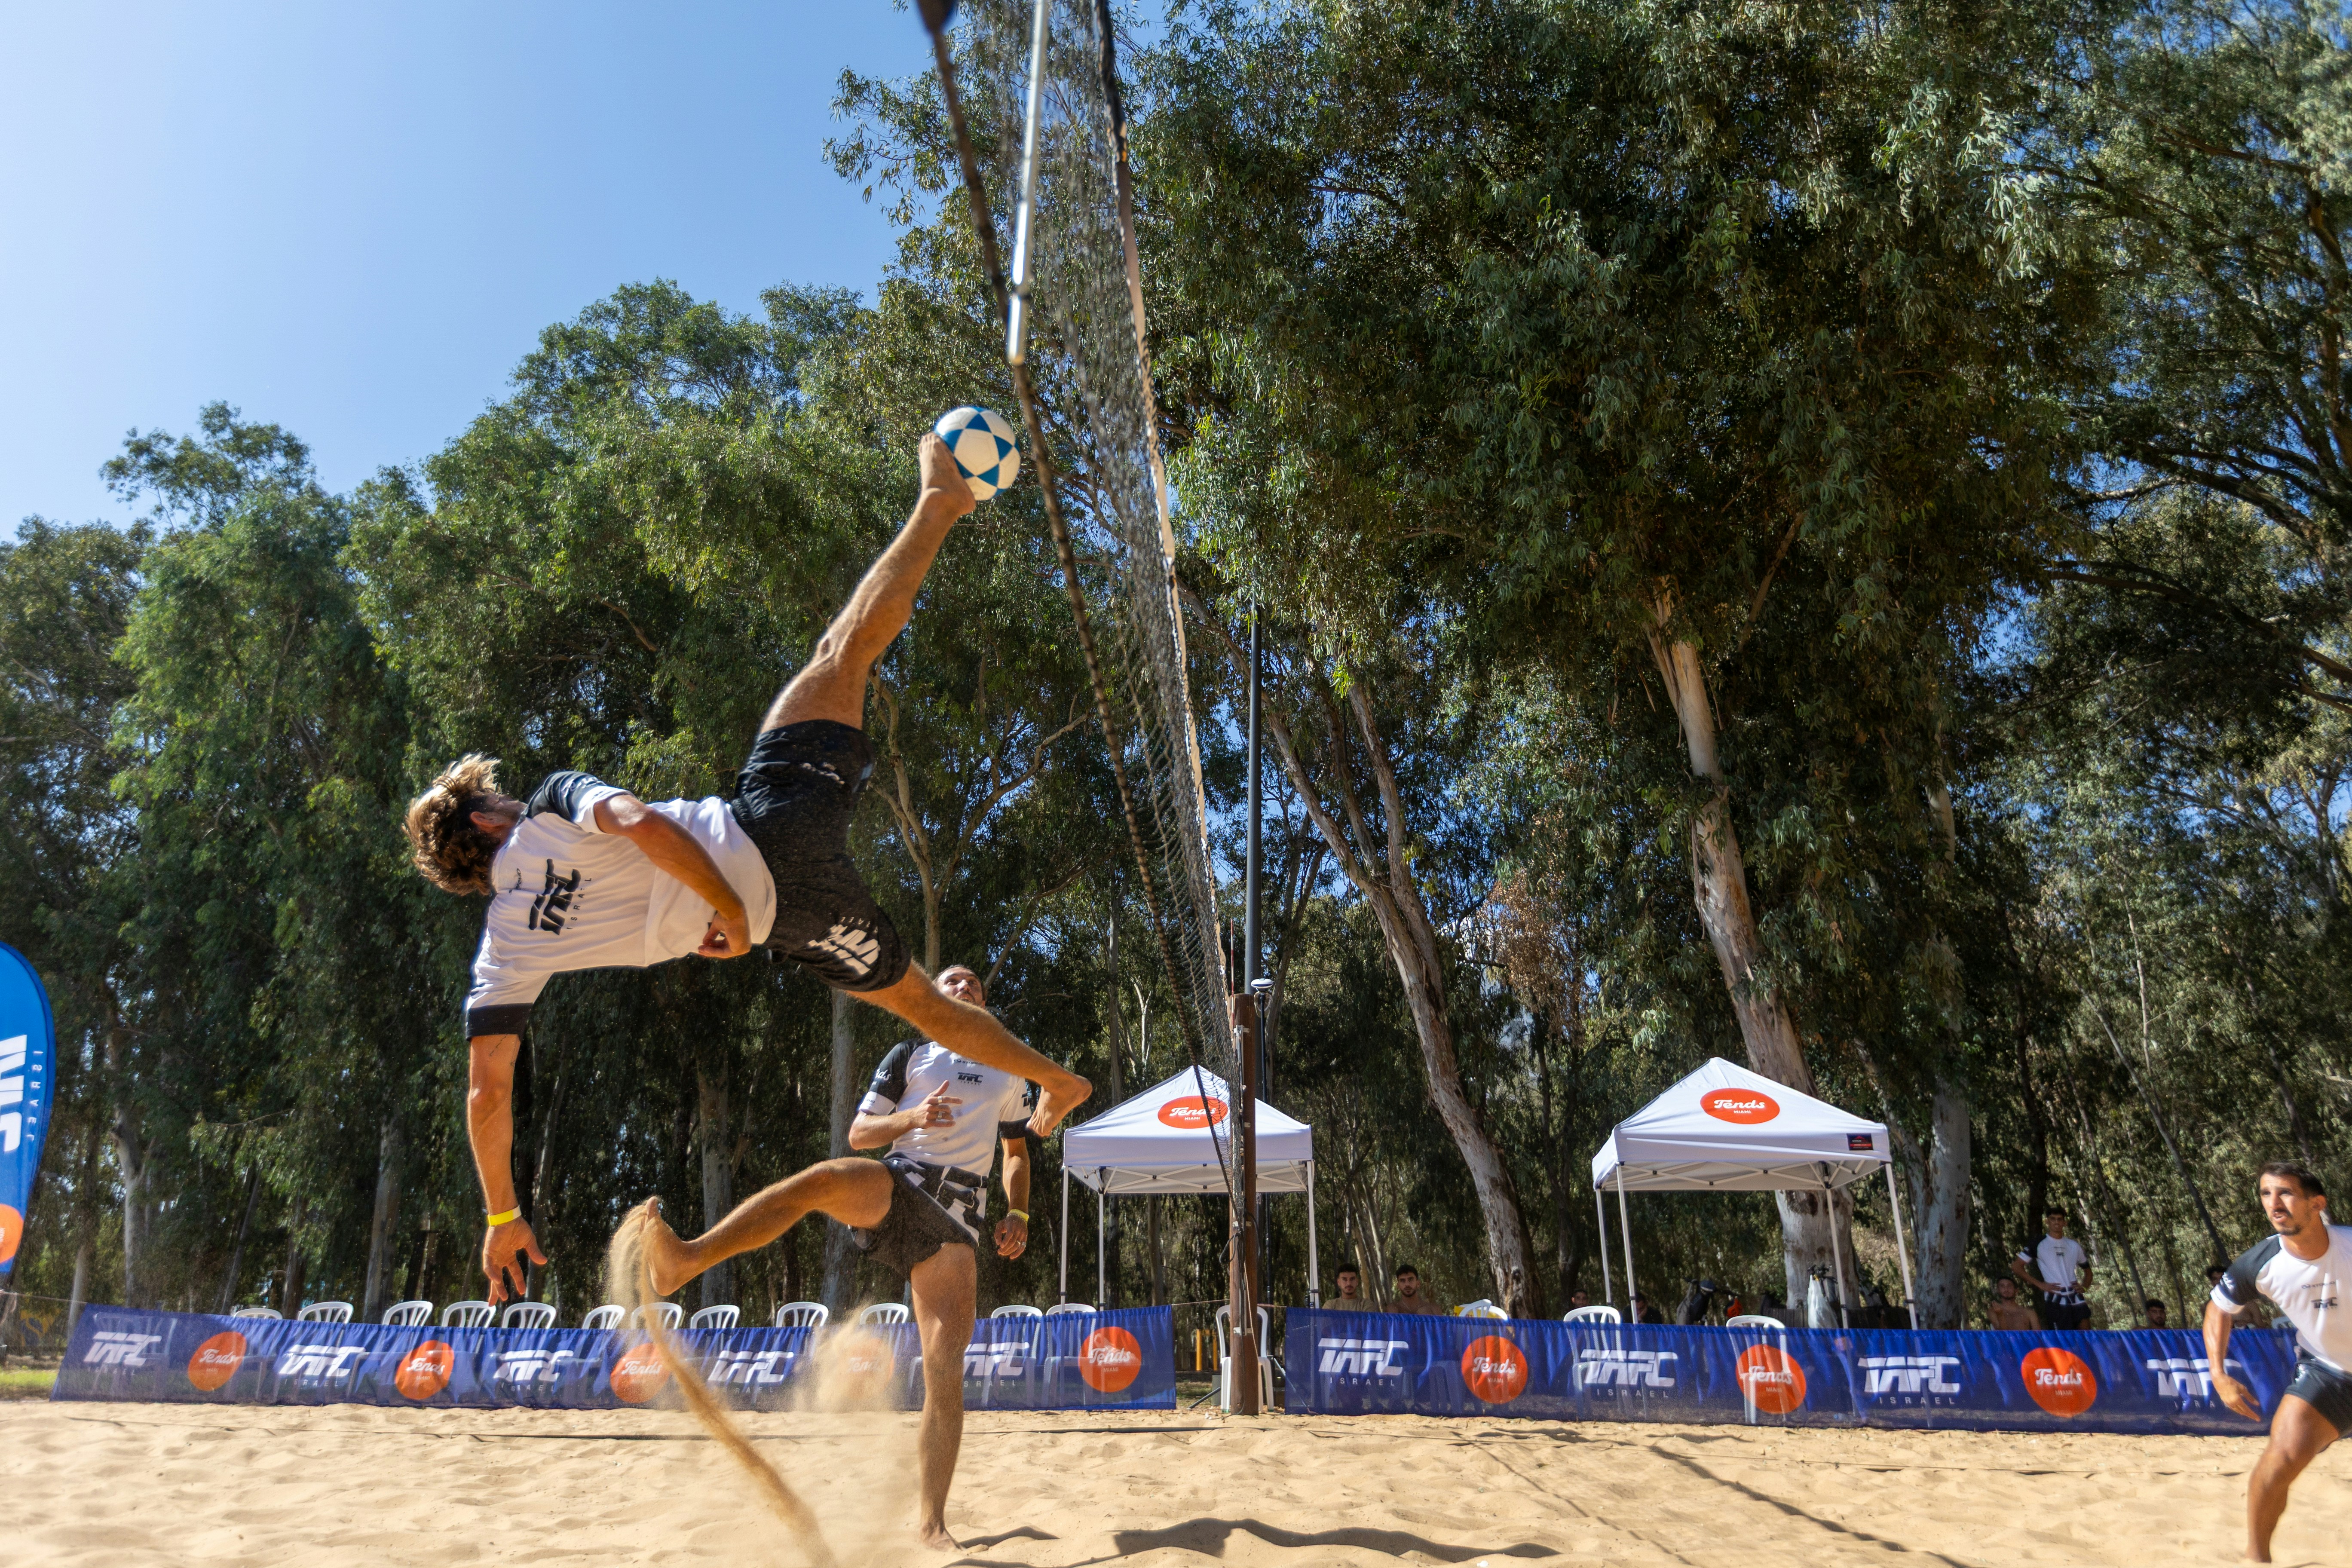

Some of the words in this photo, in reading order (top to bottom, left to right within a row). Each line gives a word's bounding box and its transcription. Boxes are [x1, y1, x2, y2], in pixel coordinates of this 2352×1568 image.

[1713, 1099, 1766, 1109] Tends
[199, 1348, 236, 1364] Tends
[964, 1341, 1030, 1376] AFC
[1089, 1348, 1131, 1364] Tends
[407, 1357, 446, 1375] Tends
[621, 1360, 663, 1375] Tends
[1473, 1356, 1516, 1374] Tends
[1330, 1377, 1395, 1386] ISRAEL
[1748, 1365, 1793, 1384] Tends
[2034, 1368, 2082, 1385] Tends
[284, 1379, 339, 1387] ISRAEL
[963, 1379, 1016, 1387] SRAEL
[1597, 1389, 1669, 1399] ISRAEL
[1880, 1396, 1955, 1405] ISRAEL
